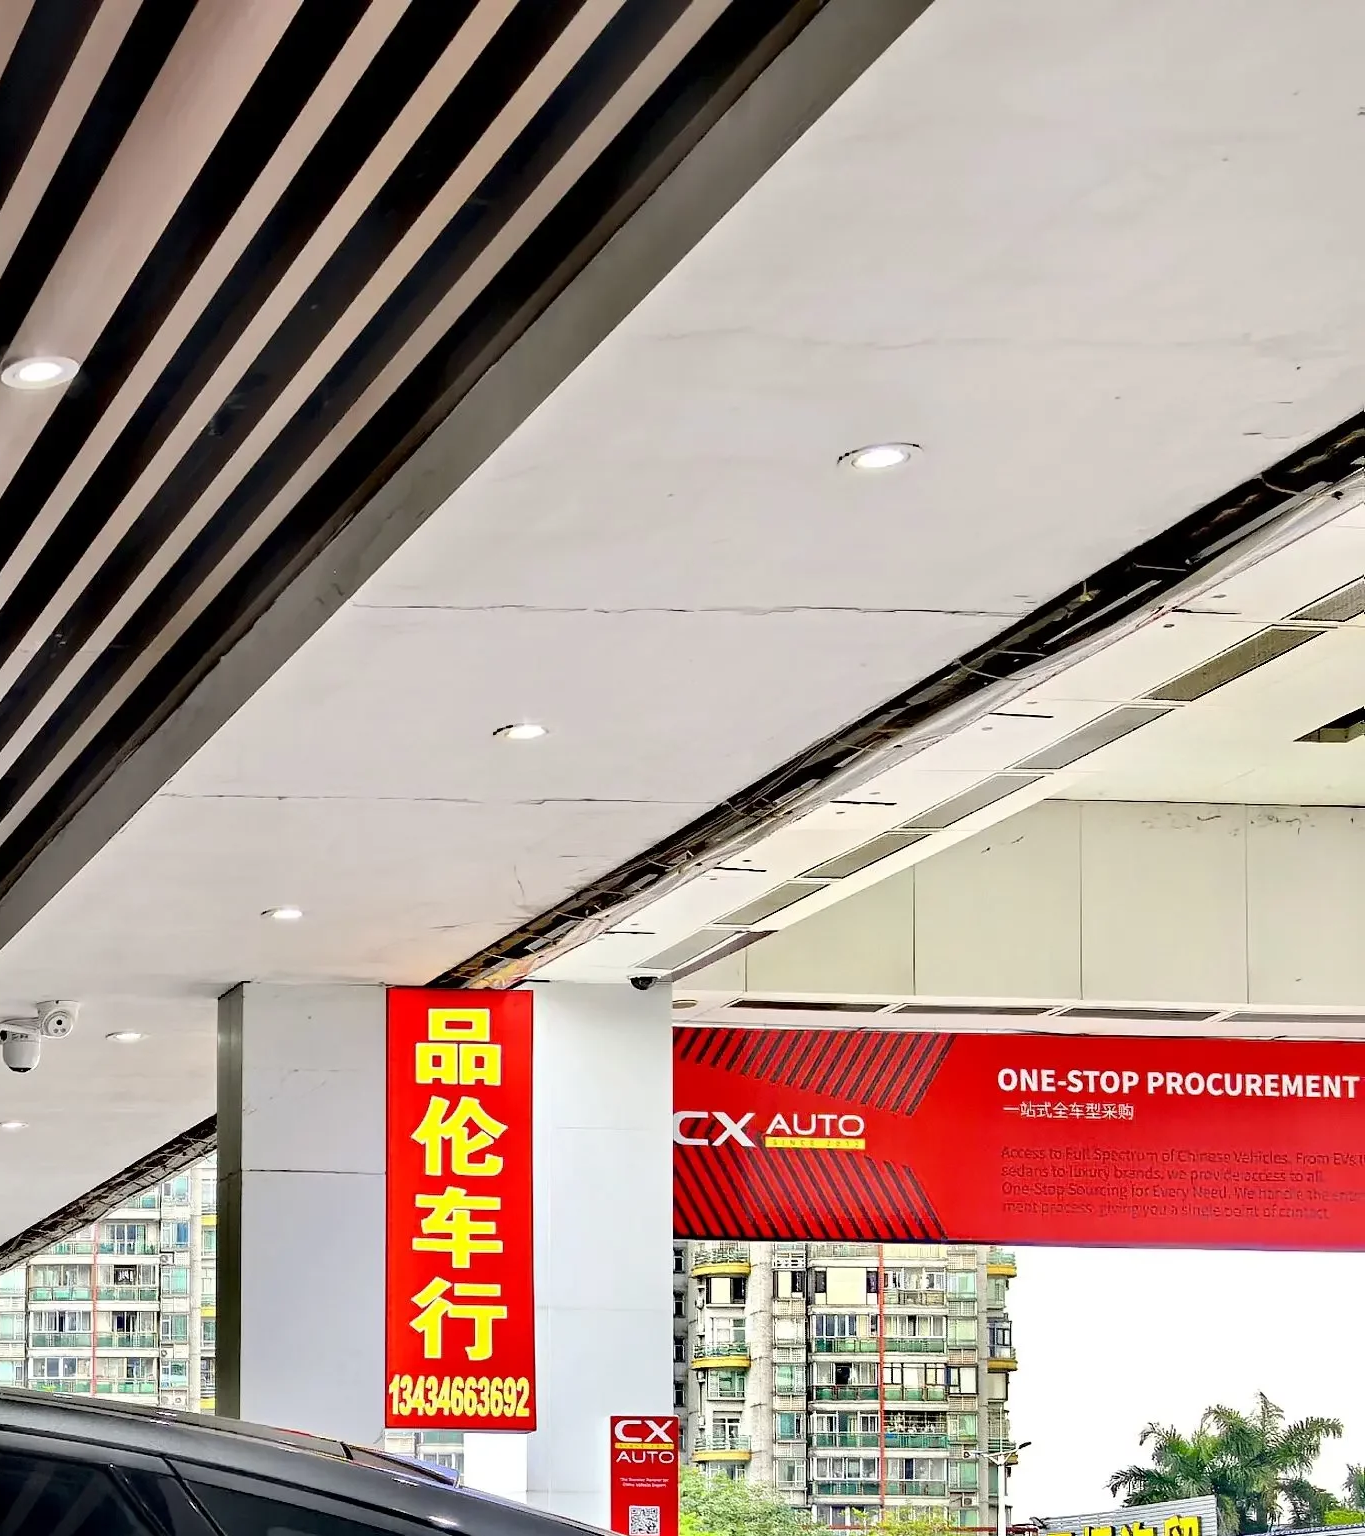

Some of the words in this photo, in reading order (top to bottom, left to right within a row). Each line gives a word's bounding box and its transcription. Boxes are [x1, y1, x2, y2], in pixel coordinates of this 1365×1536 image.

[997, 1068, 1140, 1095] ONE-STOP
[1147, 1071, 1361, 1099] PROCUREMENT
[1003, 1101, 1134, 1121] 一站式全车型采购
[673, 1110, 757, 1148] CX
[765, 1113, 865, 1137] AUTO
[410, 1008, 508, 1361] 品伦车行
[388, 1374, 530, 1417] 13434663692
[614, 1420, 673, 1443] CX
[615, 1451, 674, 1464] AUTO
